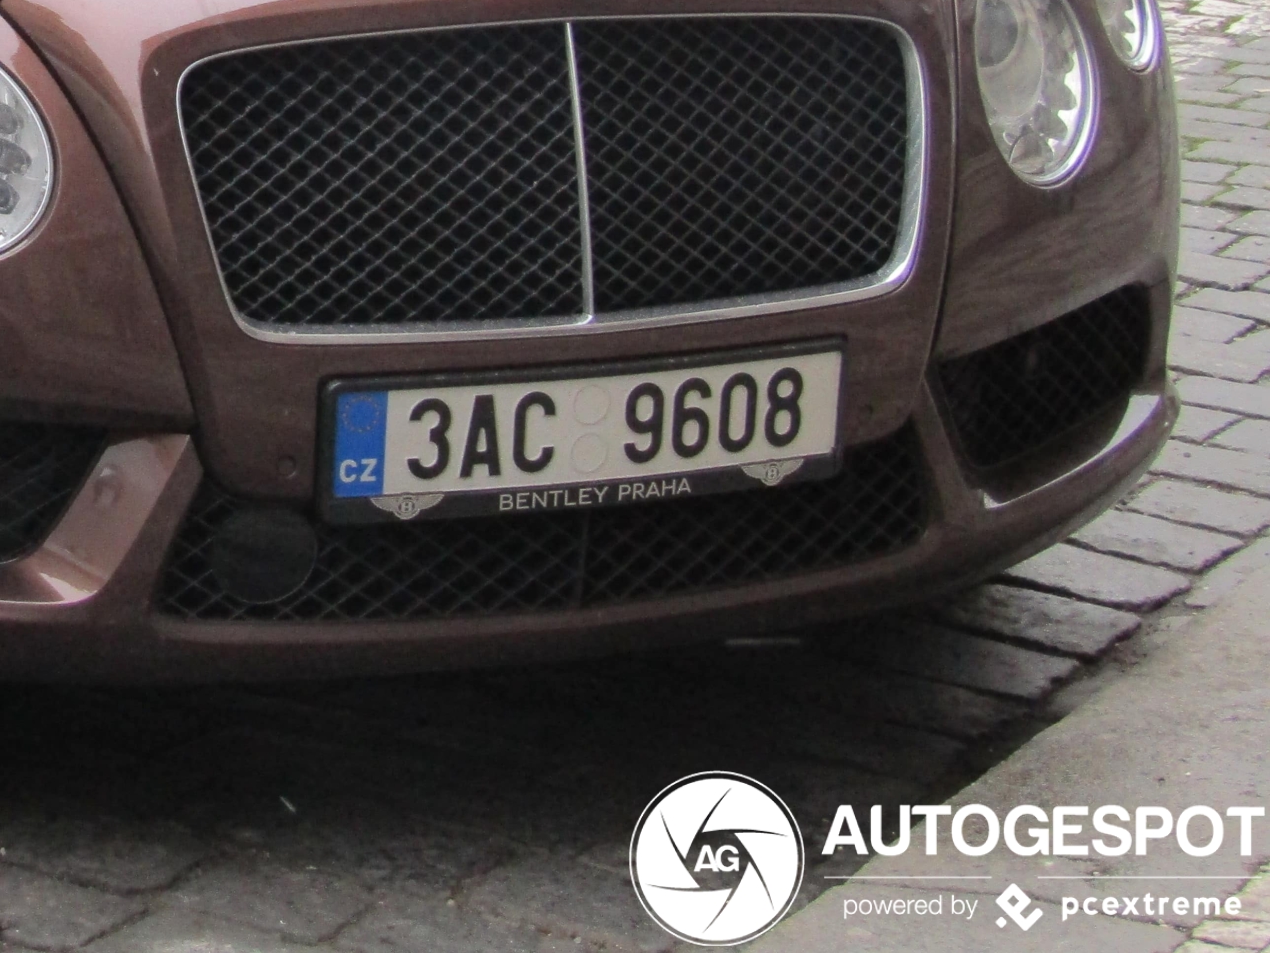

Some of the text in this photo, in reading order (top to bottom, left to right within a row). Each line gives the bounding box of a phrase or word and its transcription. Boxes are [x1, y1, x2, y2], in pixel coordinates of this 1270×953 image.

[407, 367, 803, 480] 3AC 9608
[339, 458, 378, 483] CZ
[499, 477, 692, 511] BENTLEY PRAHA
